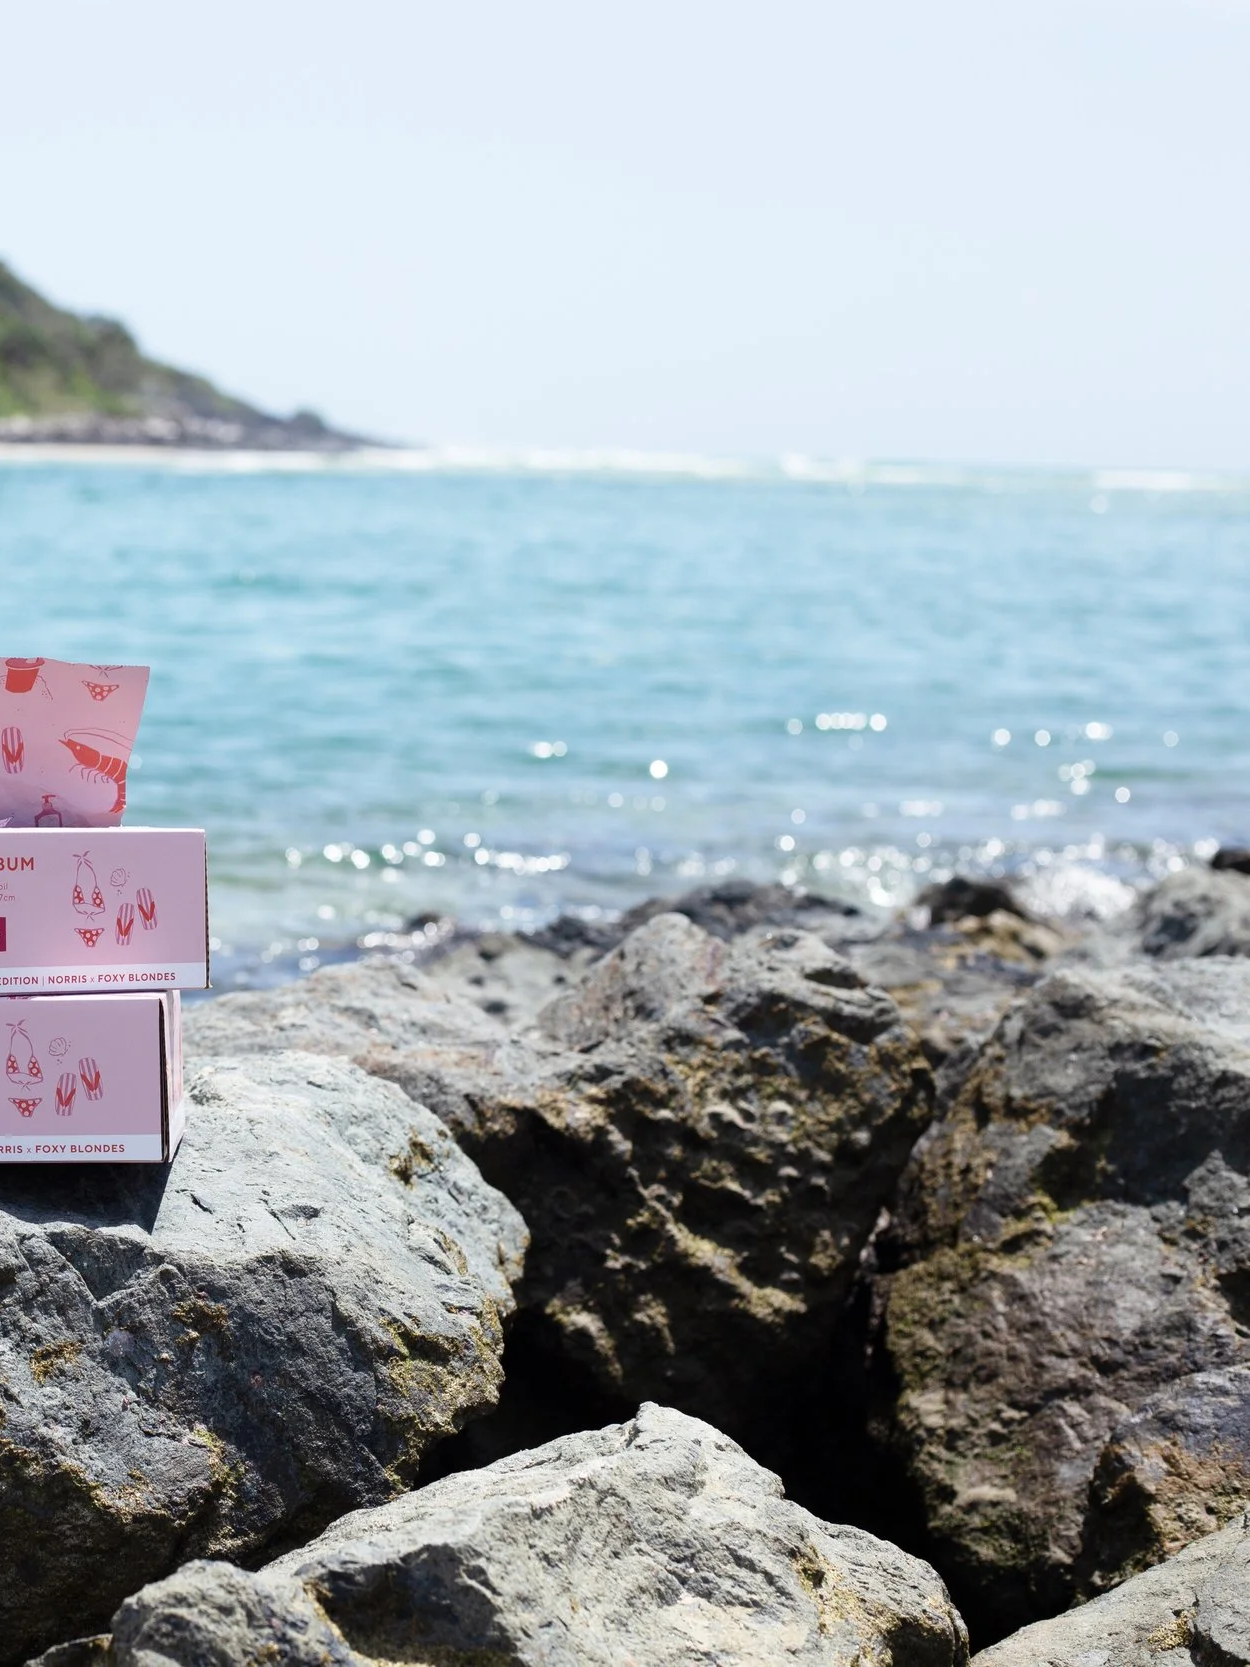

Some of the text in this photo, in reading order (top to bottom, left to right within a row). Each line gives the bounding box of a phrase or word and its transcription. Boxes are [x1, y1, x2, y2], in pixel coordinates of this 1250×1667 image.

[48, 974, 88, 985] NORRIS
[97, 973, 126, 983] FOXY
[128, 972, 177, 982] BLONDES
[35, 1144, 67, 1154] FOXY
[70, 1144, 126, 1153] BLONDES
